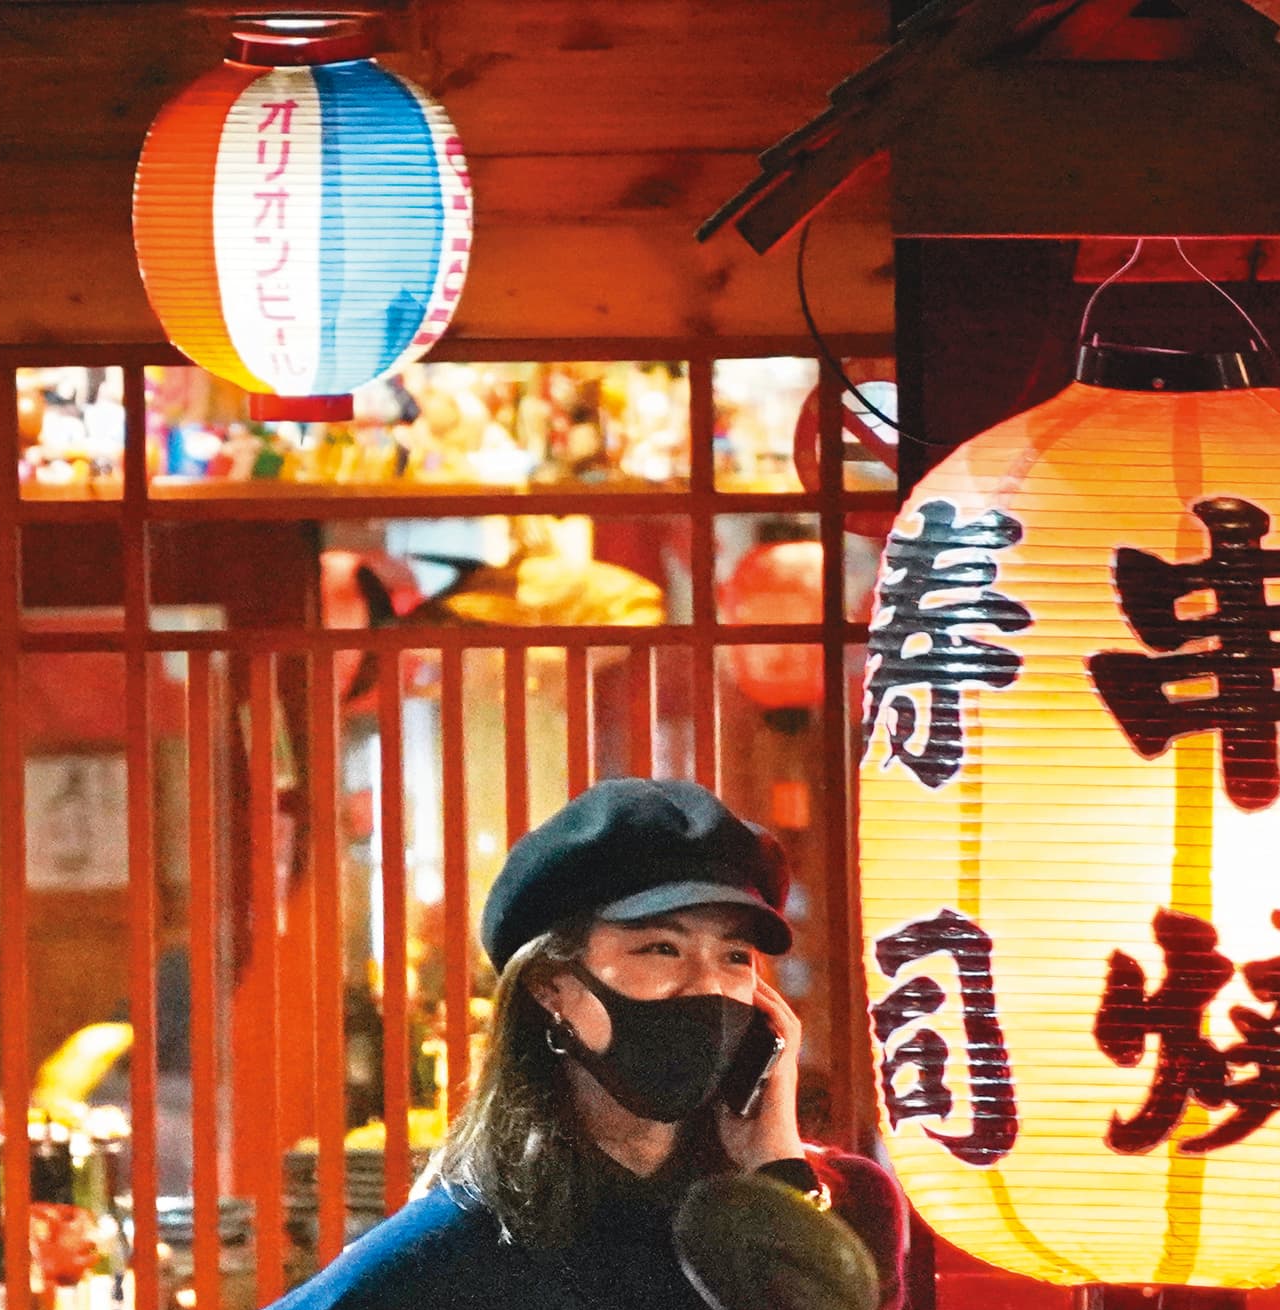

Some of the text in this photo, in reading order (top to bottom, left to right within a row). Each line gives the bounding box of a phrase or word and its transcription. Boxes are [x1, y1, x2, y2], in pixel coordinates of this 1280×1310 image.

[253, 98, 309, 378] オリオンビール
